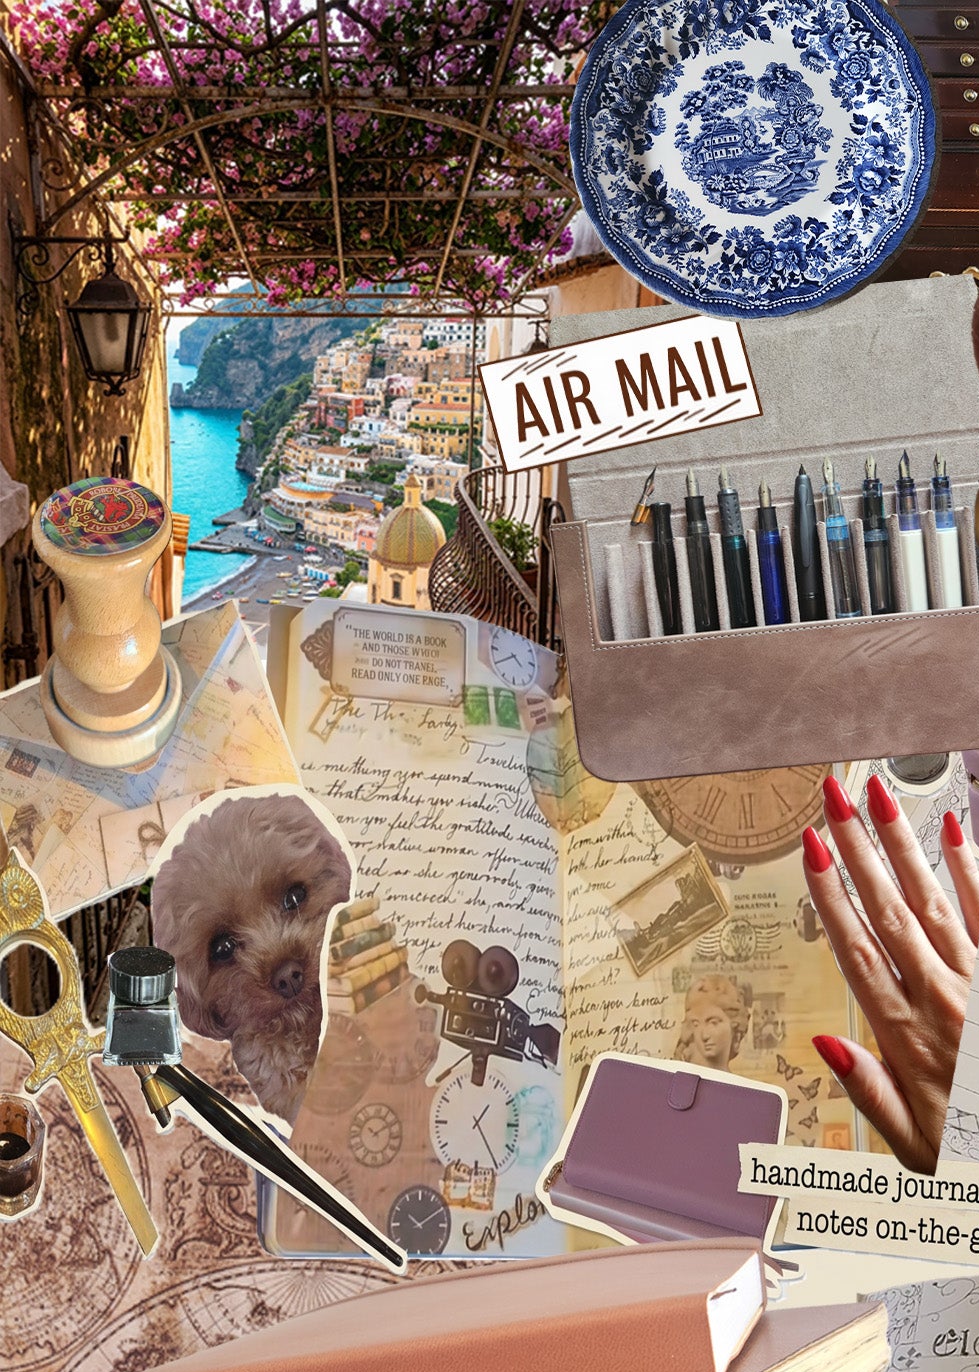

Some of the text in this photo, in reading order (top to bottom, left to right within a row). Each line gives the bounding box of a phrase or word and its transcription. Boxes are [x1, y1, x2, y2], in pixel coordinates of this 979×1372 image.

[514, 336, 747, 443] AIR MAIL
[372, 630, 404, 643] WORLD
[405, 633, 415, 644] IS
[415, 635, 422, 645] A
[424, 635, 447, 648] BOOK
[362, 642, 380, 652] AND
[382, 643, 409, 656] THOSE
[372, 657, 383, 667] DO
[384, 658, 402, 669] NOT
[351, 668, 376, 679] READ
[377, 670, 402, 682] ONLY
[402, 673, 421, 684] ONE
[751, 1158, 888, 1195] handmade
[796, 1210, 868, 1237] notes
